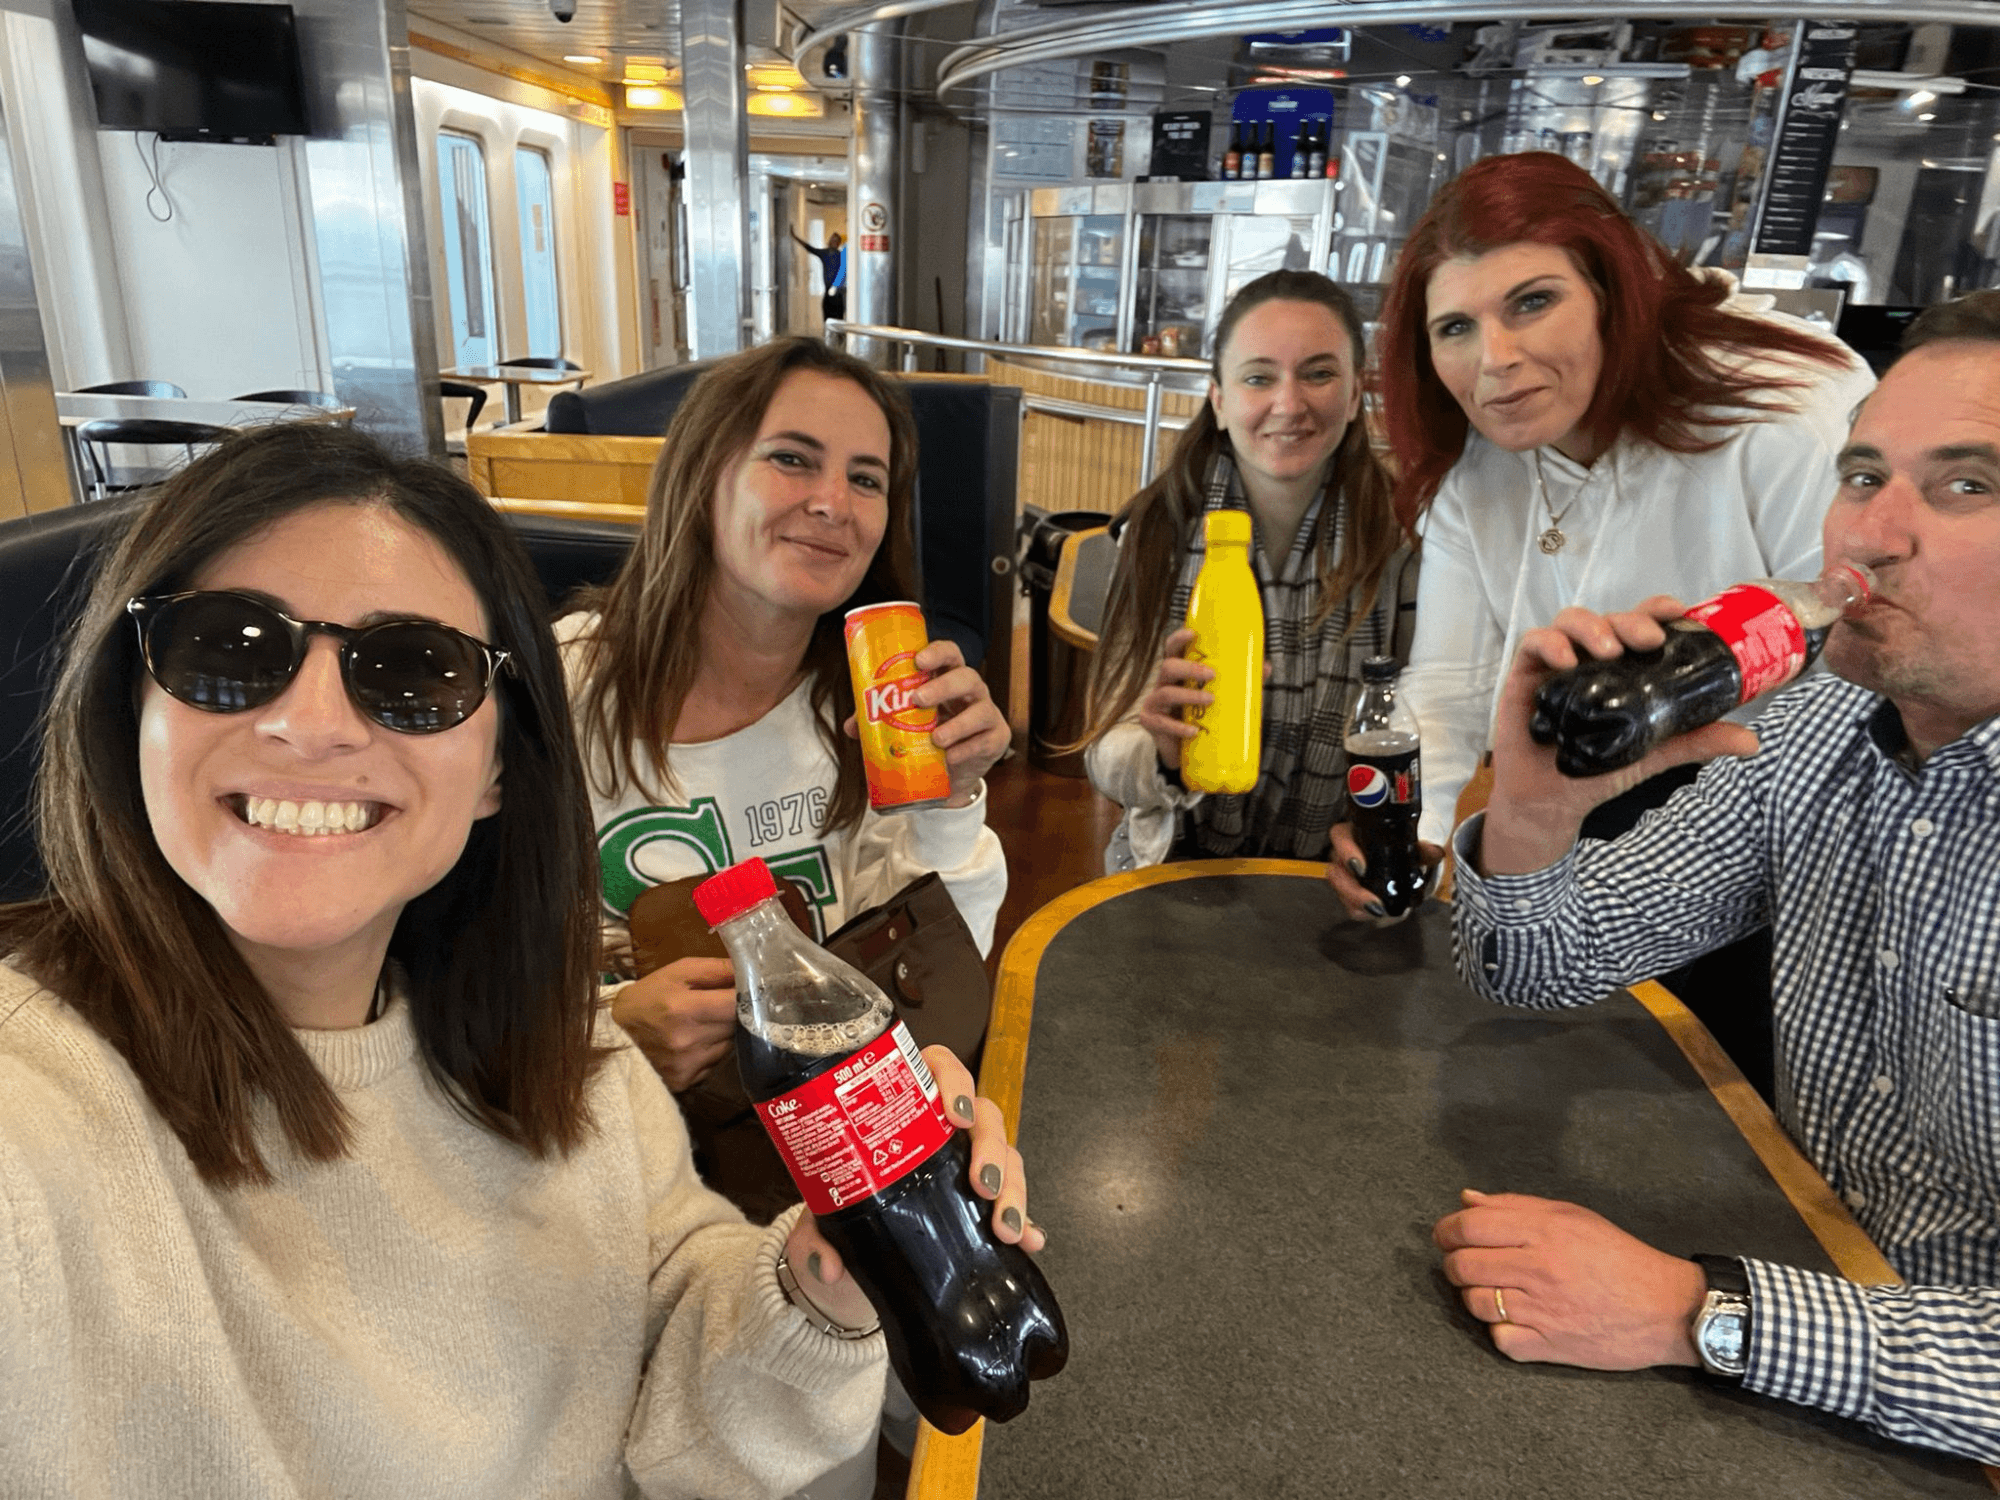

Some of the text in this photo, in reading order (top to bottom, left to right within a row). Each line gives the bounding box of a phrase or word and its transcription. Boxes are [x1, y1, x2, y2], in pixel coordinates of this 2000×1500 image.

[745, 786, 828, 847] 1976
[833, 1065, 854, 1085] 500
[852, 1057, 867, 1074] ml
